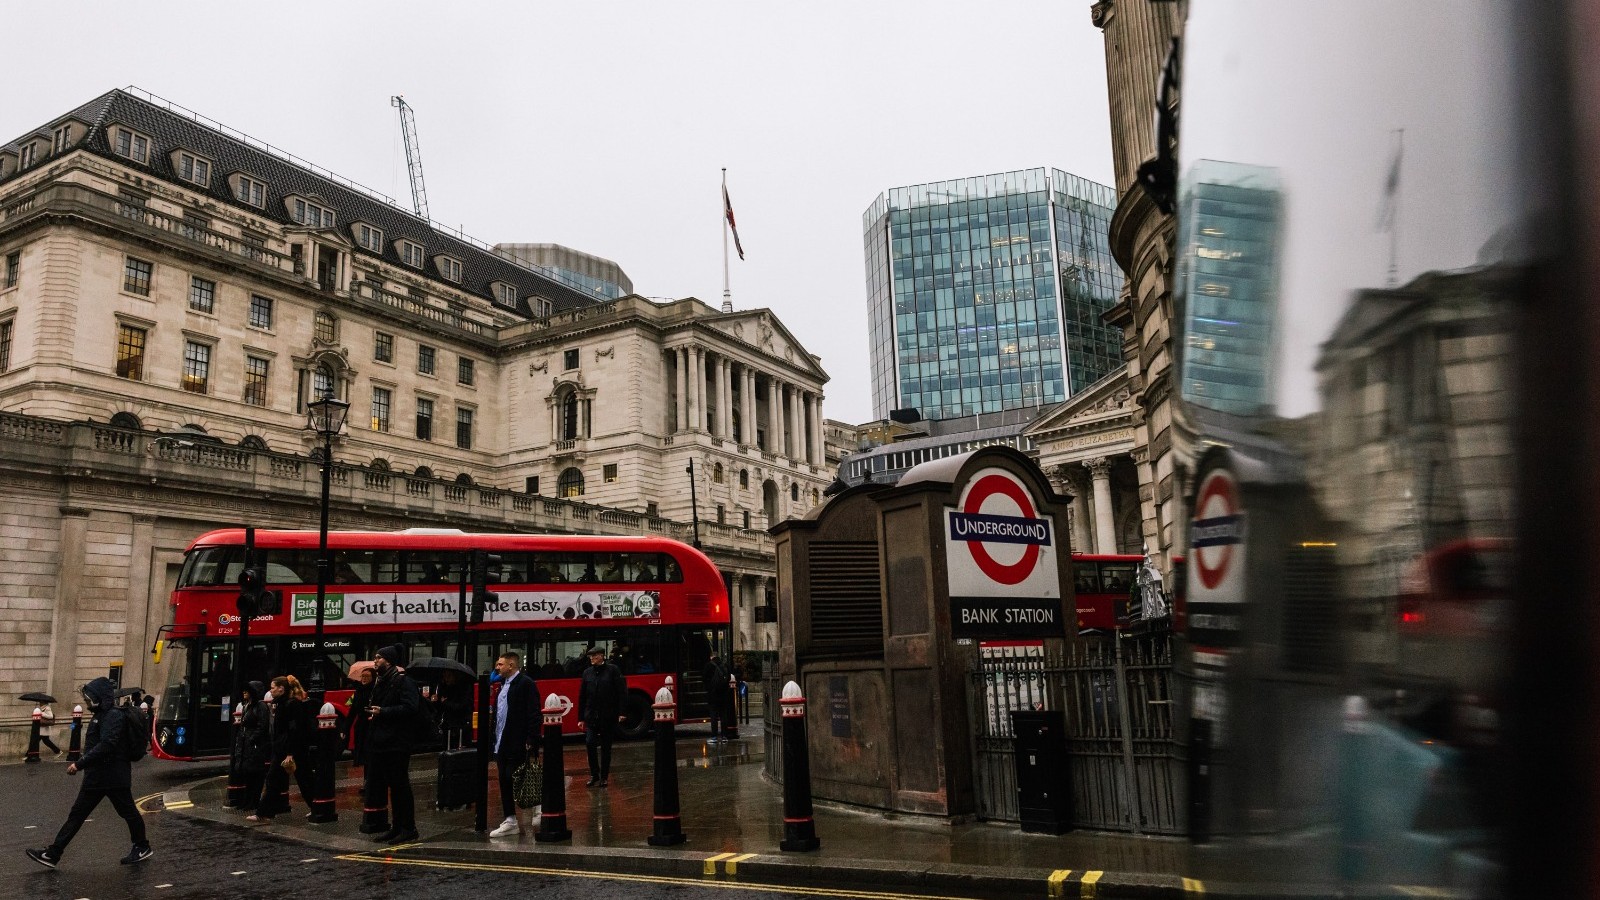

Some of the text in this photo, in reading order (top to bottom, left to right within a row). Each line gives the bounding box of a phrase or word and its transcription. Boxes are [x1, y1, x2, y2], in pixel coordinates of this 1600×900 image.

[1051, 440, 1074, 451] ANNO
[955, 517, 1046, 540] UNDERGROUND
[351, 599, 387, 615] Gut
[392, 598, 457, 616] health,
[514, 598, 561, 614] tasty.
[613, 604, 631, 612] kefir
[961, 608, 1054, 624] BANK STATION
[291, 641, 298, 650] 8
